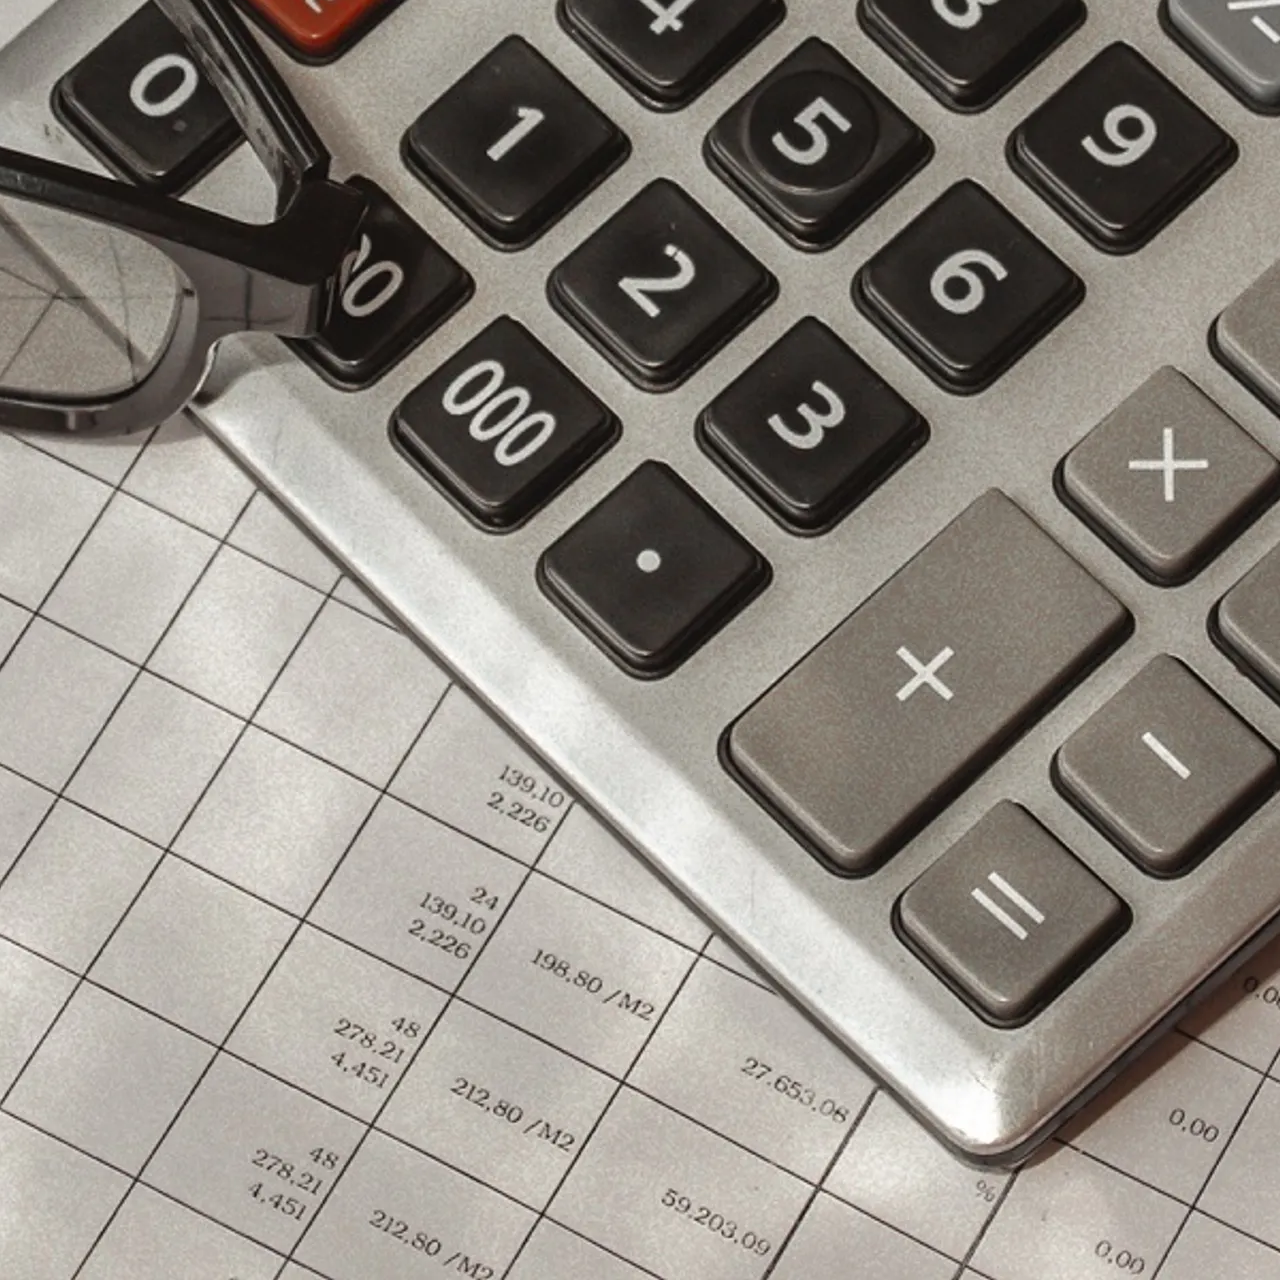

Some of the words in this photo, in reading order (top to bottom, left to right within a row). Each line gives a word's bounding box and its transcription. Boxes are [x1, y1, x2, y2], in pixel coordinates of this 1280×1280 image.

[129, 53, 200, 119] 0
[485, 106, 546, 163] 1
[770, 96, 852, 169] 5
[1080, 103, 1159, 169] 9
[617, 244, 698, 319] 2
[928, 247, 1008, 315] 6
[441, 359, 558, 469] 000
[765, 380, 847, 453] 3
[468, 885, 499, 911] 24
[389, 1015, 421, 1038] 48
